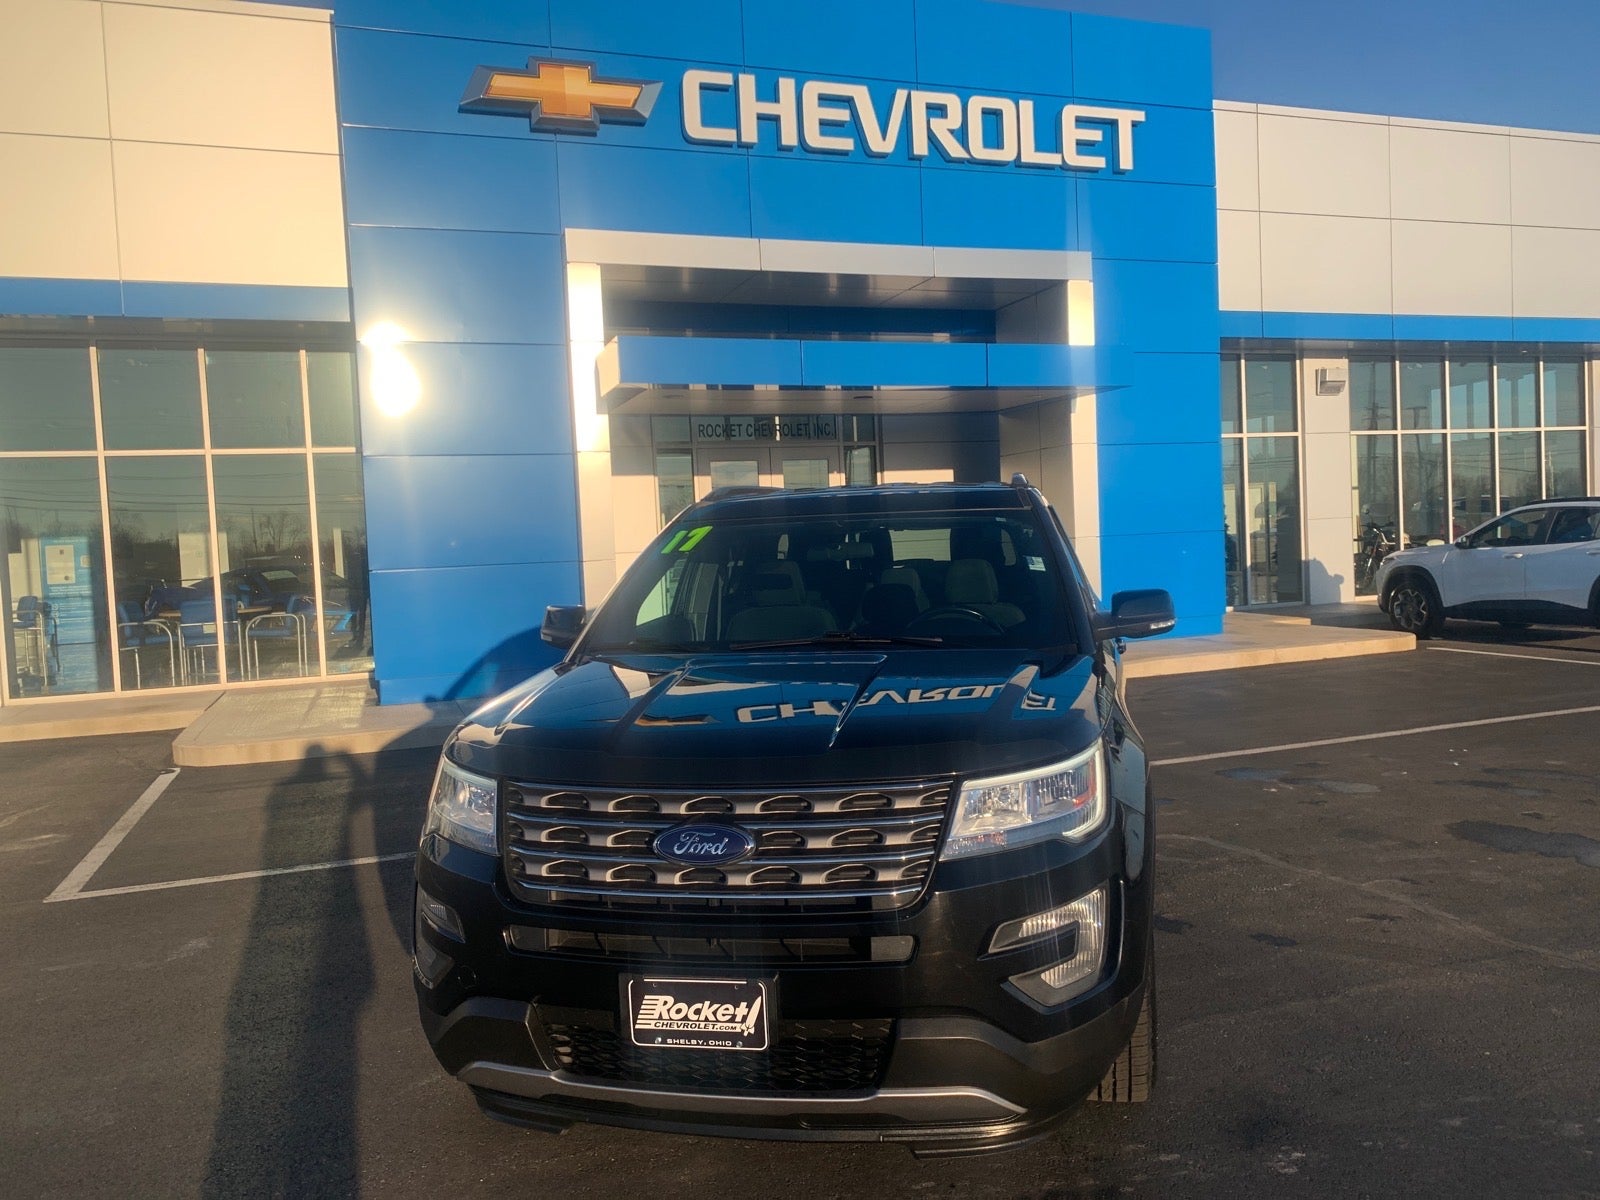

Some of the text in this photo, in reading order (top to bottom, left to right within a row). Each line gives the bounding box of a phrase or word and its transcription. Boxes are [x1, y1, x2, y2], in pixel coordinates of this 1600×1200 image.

[681, 69, 1146, 173] CHEVROLET
[698, 423, 742, 438] ROCKET
[661, 525, 713, 554] 17
[673, 831, 729, 855] Ford
